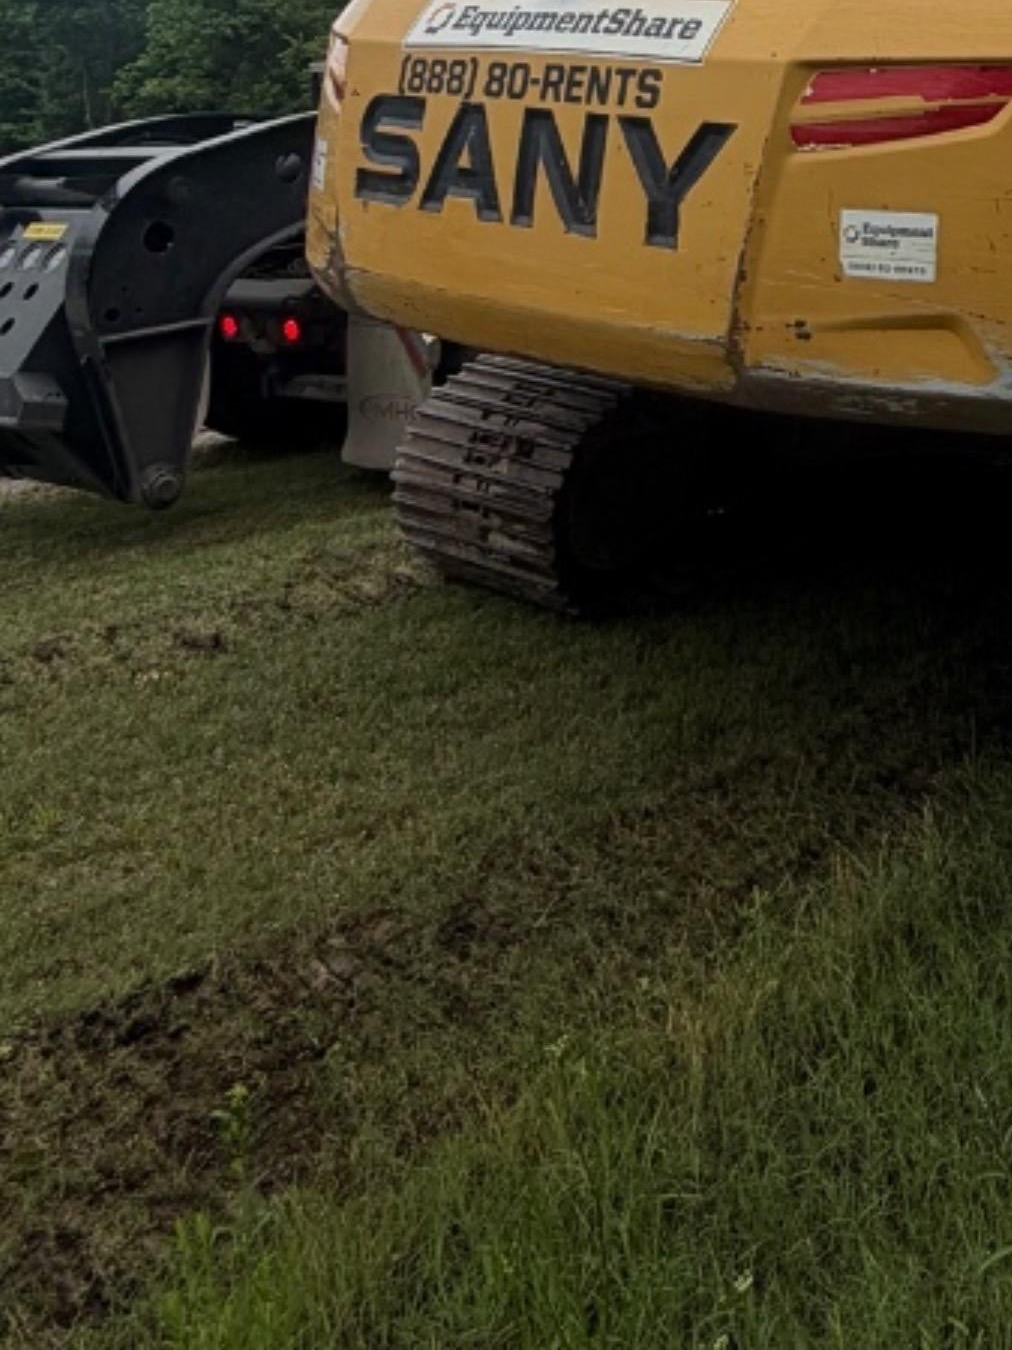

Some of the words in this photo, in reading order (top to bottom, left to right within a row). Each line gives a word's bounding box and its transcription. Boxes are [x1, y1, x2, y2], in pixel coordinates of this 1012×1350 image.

[452, 4, 703, 40] EquipmentShare
[399, 53, 479, 99] (888)
[484, 61, 664, 110] 80-RENTS
[354, 92, 740, 252] SANY
